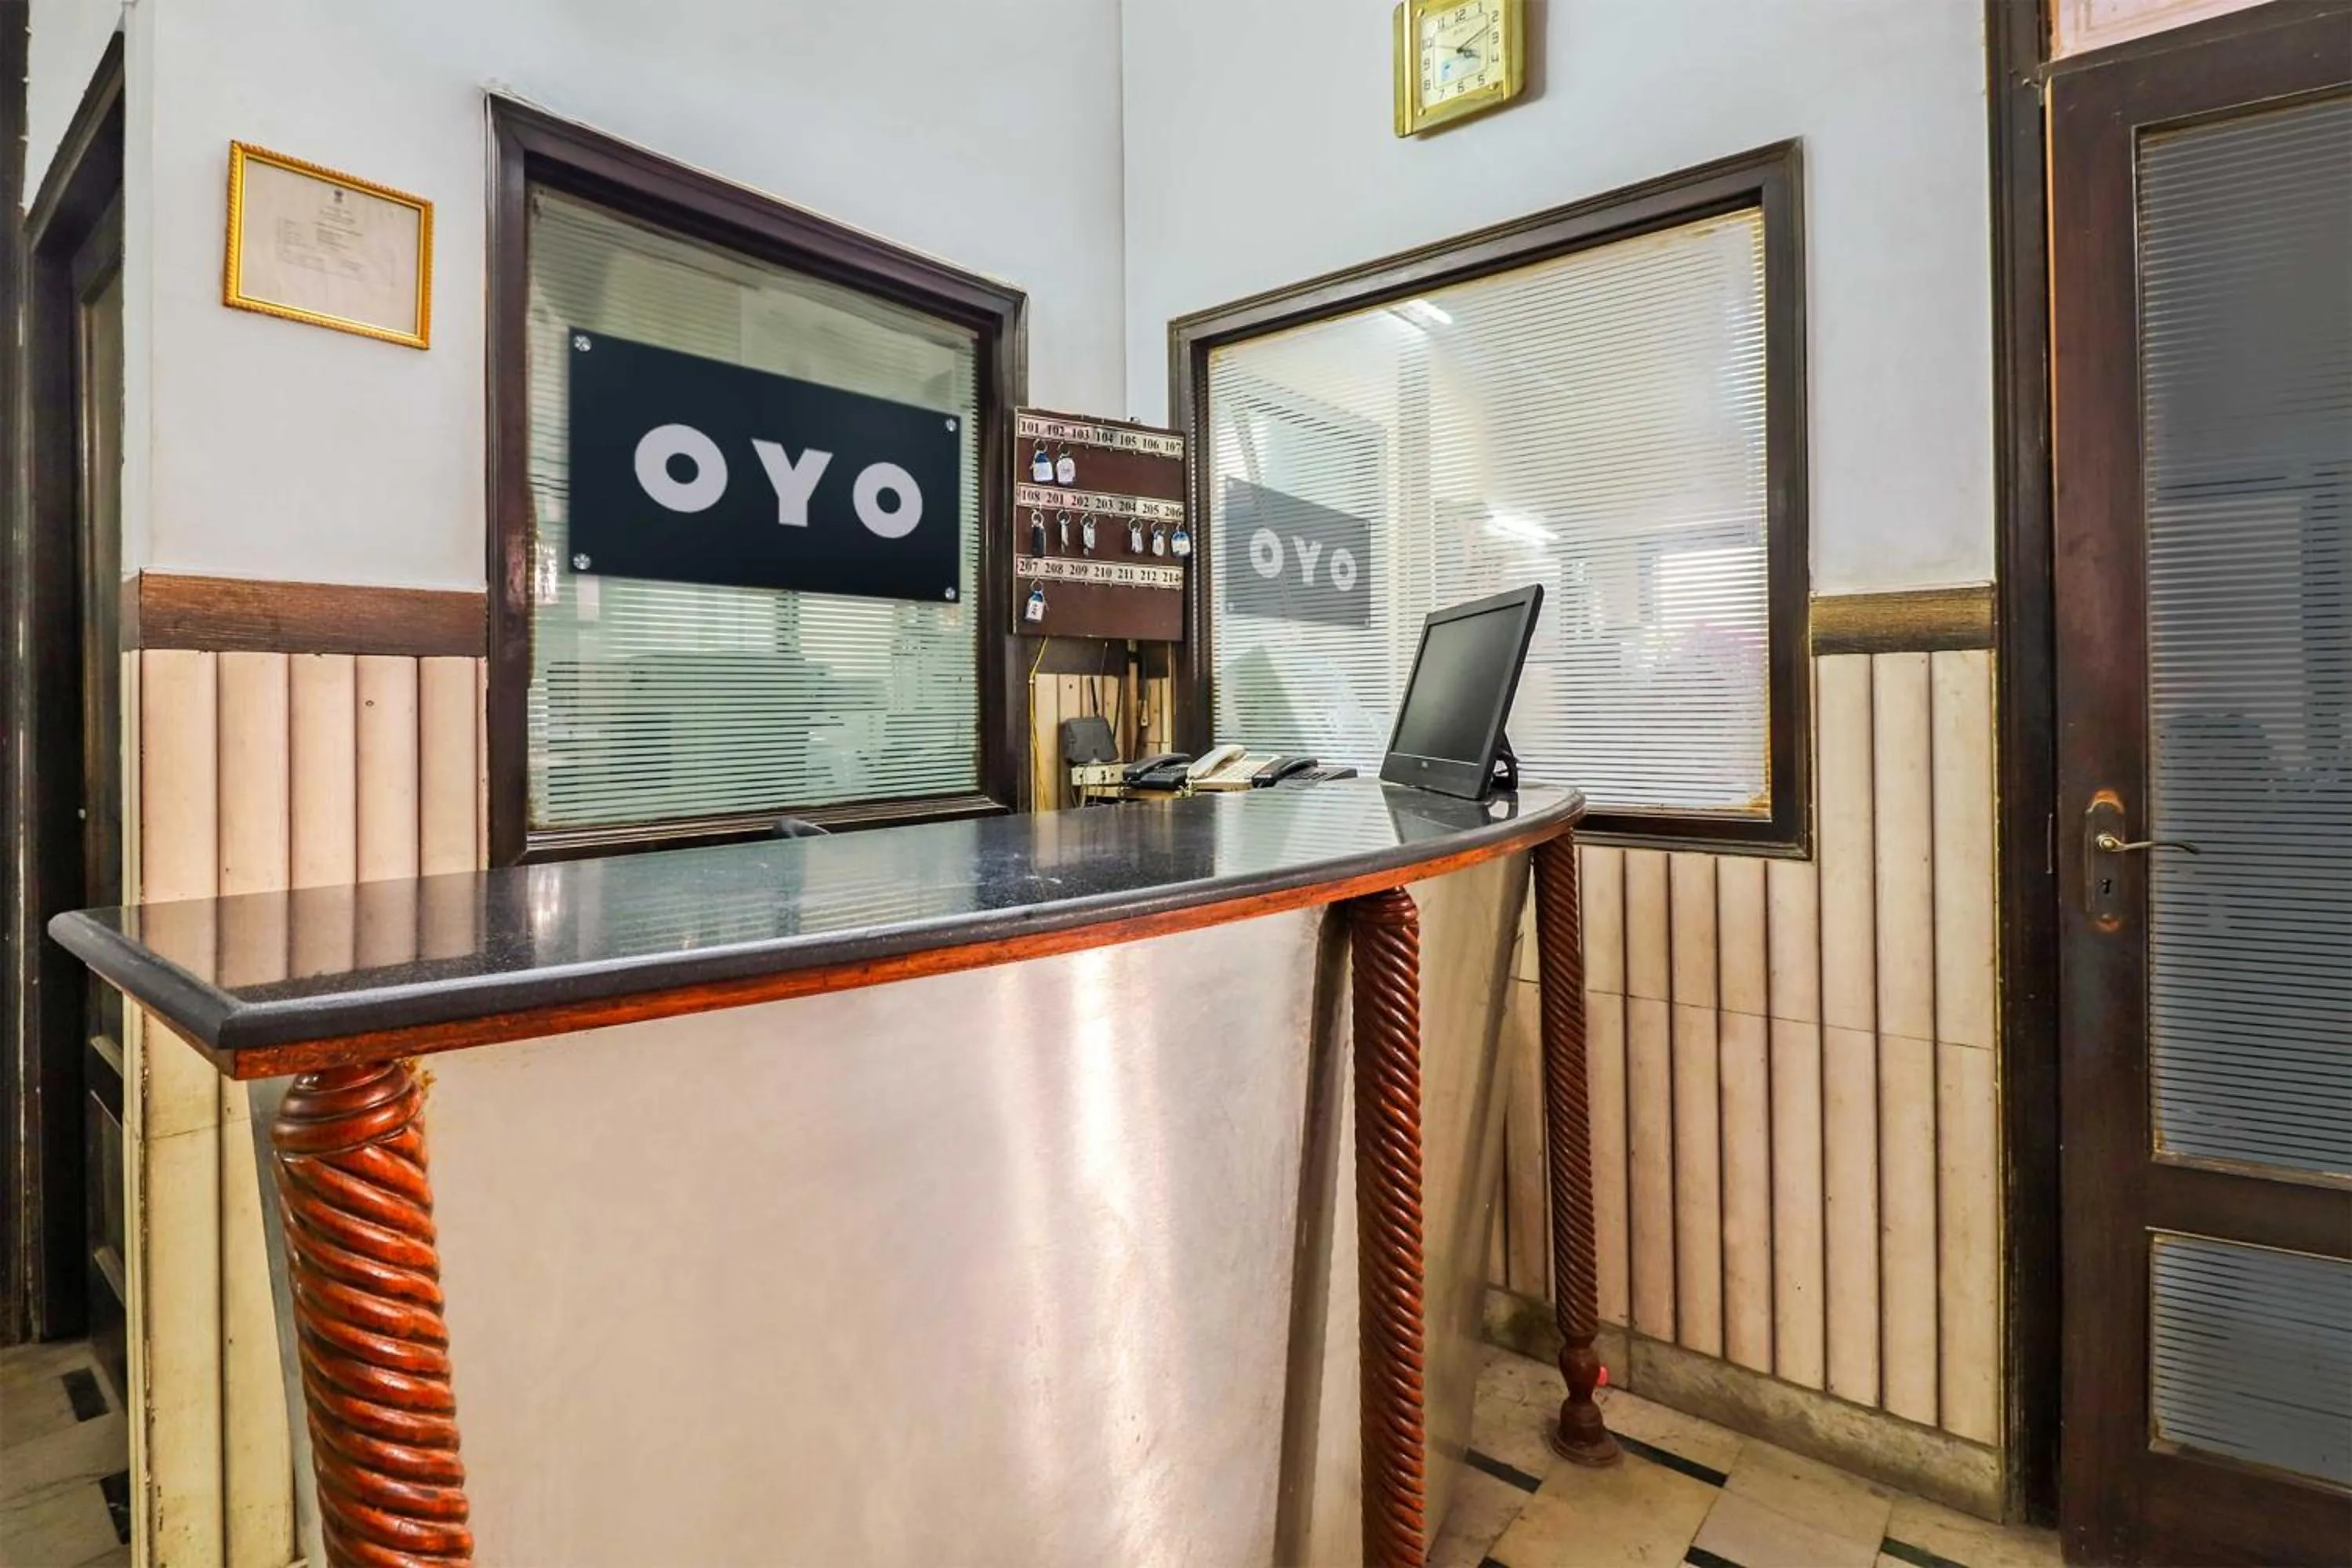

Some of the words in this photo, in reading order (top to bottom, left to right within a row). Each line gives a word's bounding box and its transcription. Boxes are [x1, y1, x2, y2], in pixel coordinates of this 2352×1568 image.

[1455, 9, 1466, 23] 12
[1491, 10, 1499, 23] 2
[1491, 31, 1499, 45] 3
[1423, 58, 1431, 71] 9
[1457, 81, 1465, 93] 6
[1478, 74, 1486, 86] 5
[1021, 421, 1039, 434] 101
[1047, 424, 1065, 437] 102
[1072, 427, 1089, 440] 103
[1097, 430, 1113, 443] 104
[1120, 434, 1137, 446] 105
[1143, 438, 1160, 449] 106
[1165, 441, 1181, 452] 107
[634, 423, 923, 539] OYO
[1022, 489, 1040, 501] 108
[1047, 492, 1064, 505] 201
[1071, 495, 1089, 507] 202
[1095, 497, 1113, 510] 203
[1119, 500, 1136, 513] 204
[1142, 503, 1160, 515] 205
[1165, 506, 1182, 517] 206
[1019, 561, 1038, 572] 207
[1045, 562, 1064, 575] 208
[1070, 564, 1088, 576] 209
[1094, 566, 1112, 579] 210
[1118, 568, 1134, 579] 211
[1141, 570, 1157, 581] 212
